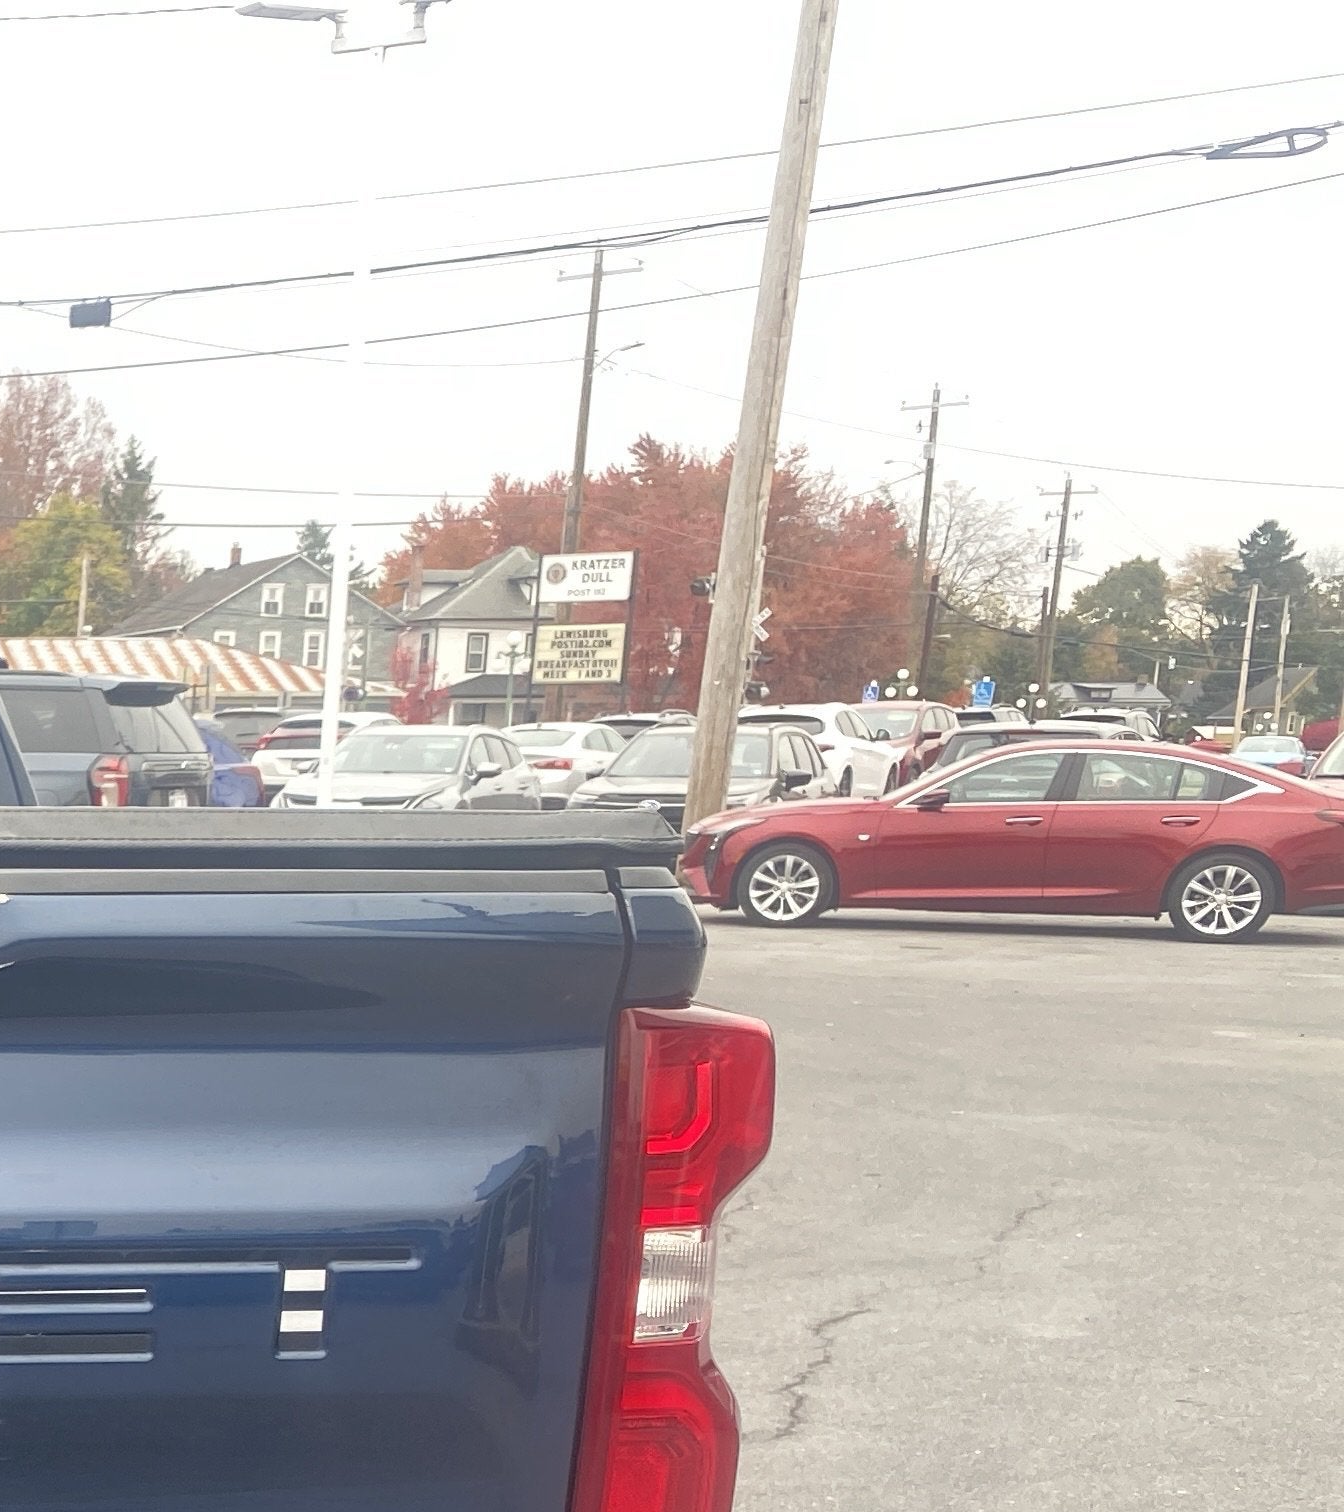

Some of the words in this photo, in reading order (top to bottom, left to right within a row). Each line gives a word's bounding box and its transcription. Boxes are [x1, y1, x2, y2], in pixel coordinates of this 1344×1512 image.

[571, 558, 626, 571] KRATZER
[582, 572, 613, 583] DULL
[567, 589, 591, 597] POST
[554, 629, 609, 640] LEWISBURG
[551, 639, 612, 650] POST182.COM
[560, 650, 597, 659] SUNDAY
[543, 670, 567, 679] WEEK
[585, 670, 603, 678] AND
